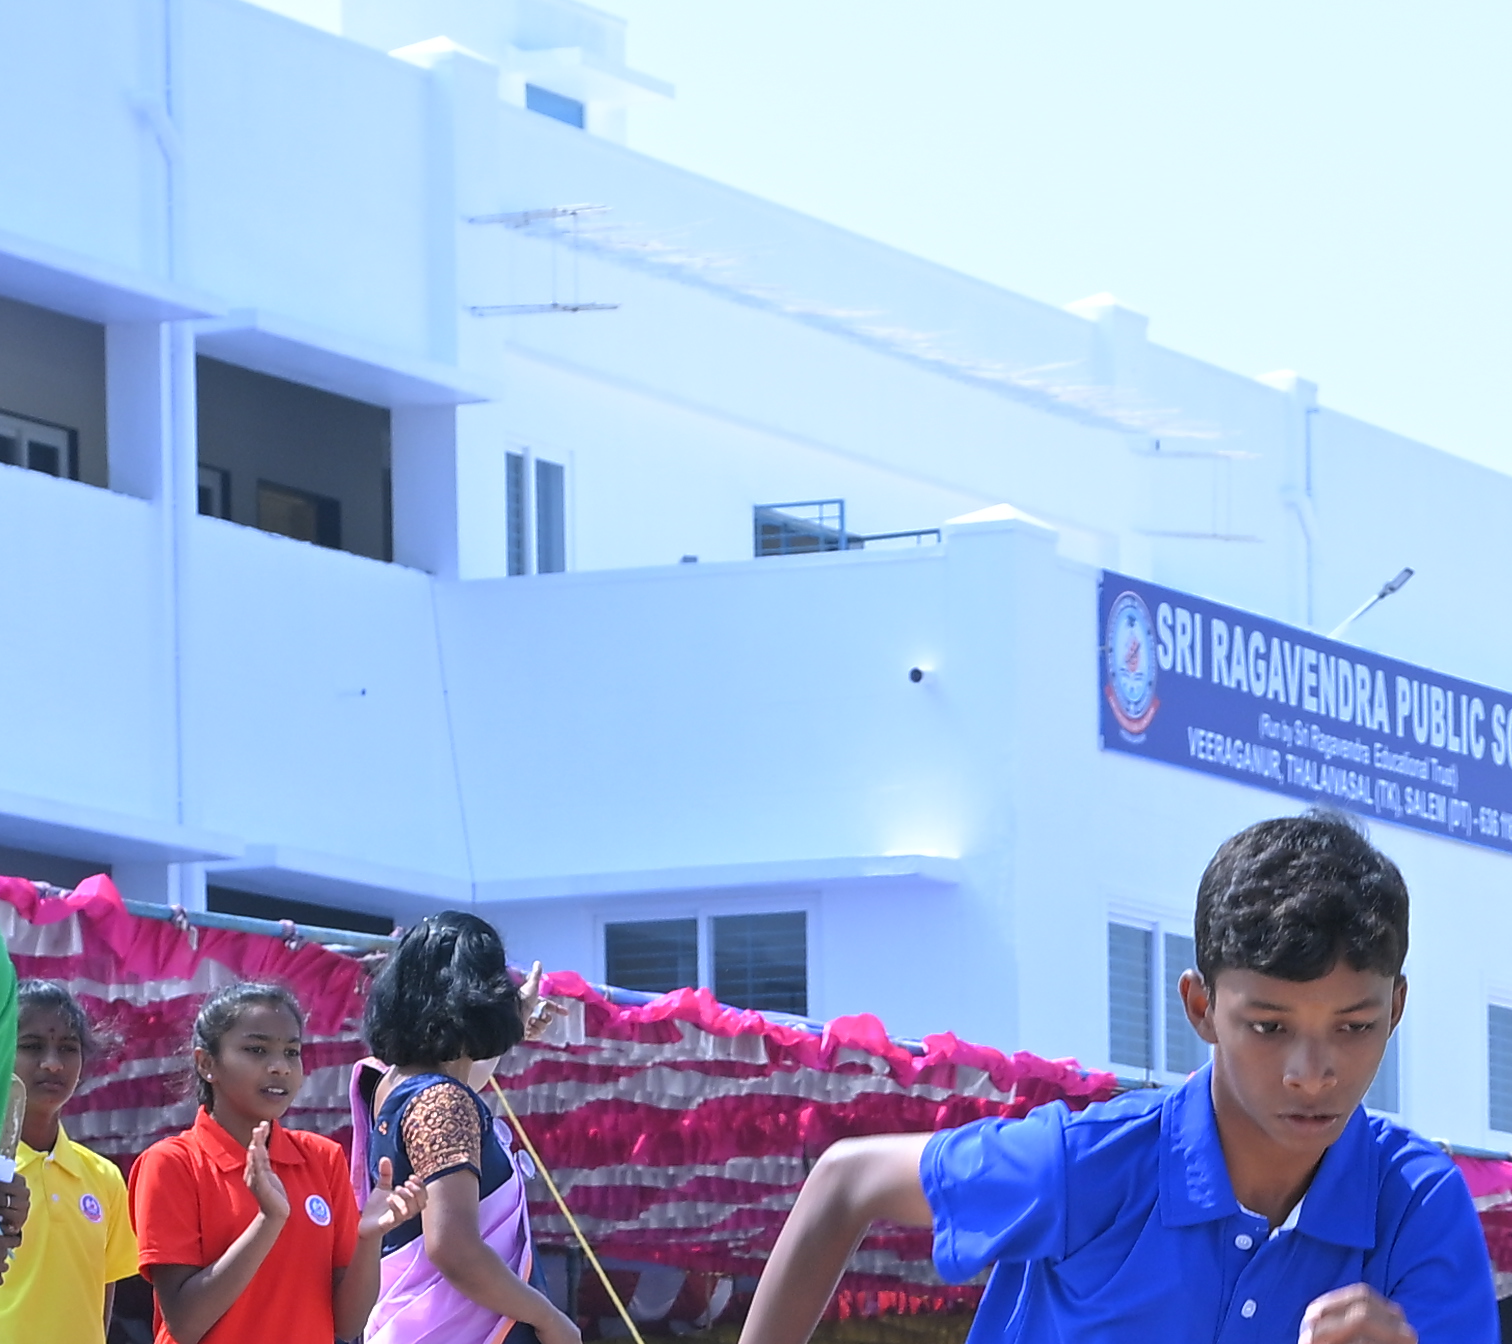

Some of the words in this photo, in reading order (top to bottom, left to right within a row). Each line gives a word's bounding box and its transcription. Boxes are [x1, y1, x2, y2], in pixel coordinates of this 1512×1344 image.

[1156, 601, 1203, 679] SRI
[1210, 617, 1389, 735] RAGAVENDRA
[1395, 676, 1486, 761] PUBLIC
[1404, 786, 1447, 823] SALEM
